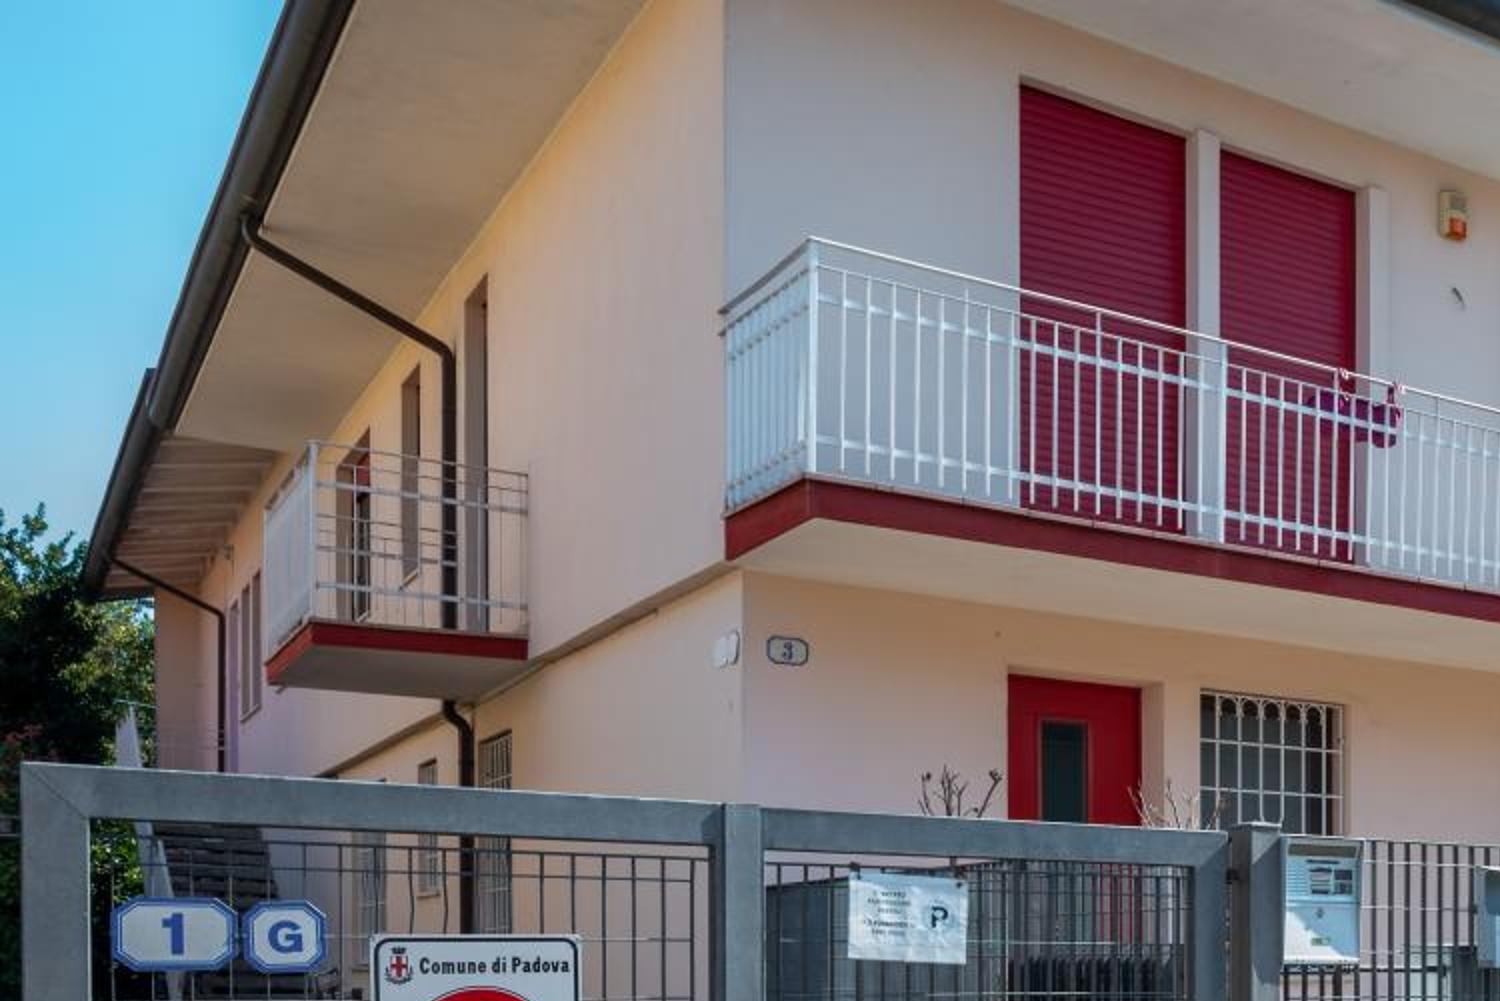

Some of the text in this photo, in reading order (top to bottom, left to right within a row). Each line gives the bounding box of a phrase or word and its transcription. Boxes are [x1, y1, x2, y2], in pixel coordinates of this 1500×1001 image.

[782, 641, 793, 660] 3
[161, 913, 184, 955] 1
[267, 920, 304, 954] G
[419, 956, 570, 974] Comune di Padova
